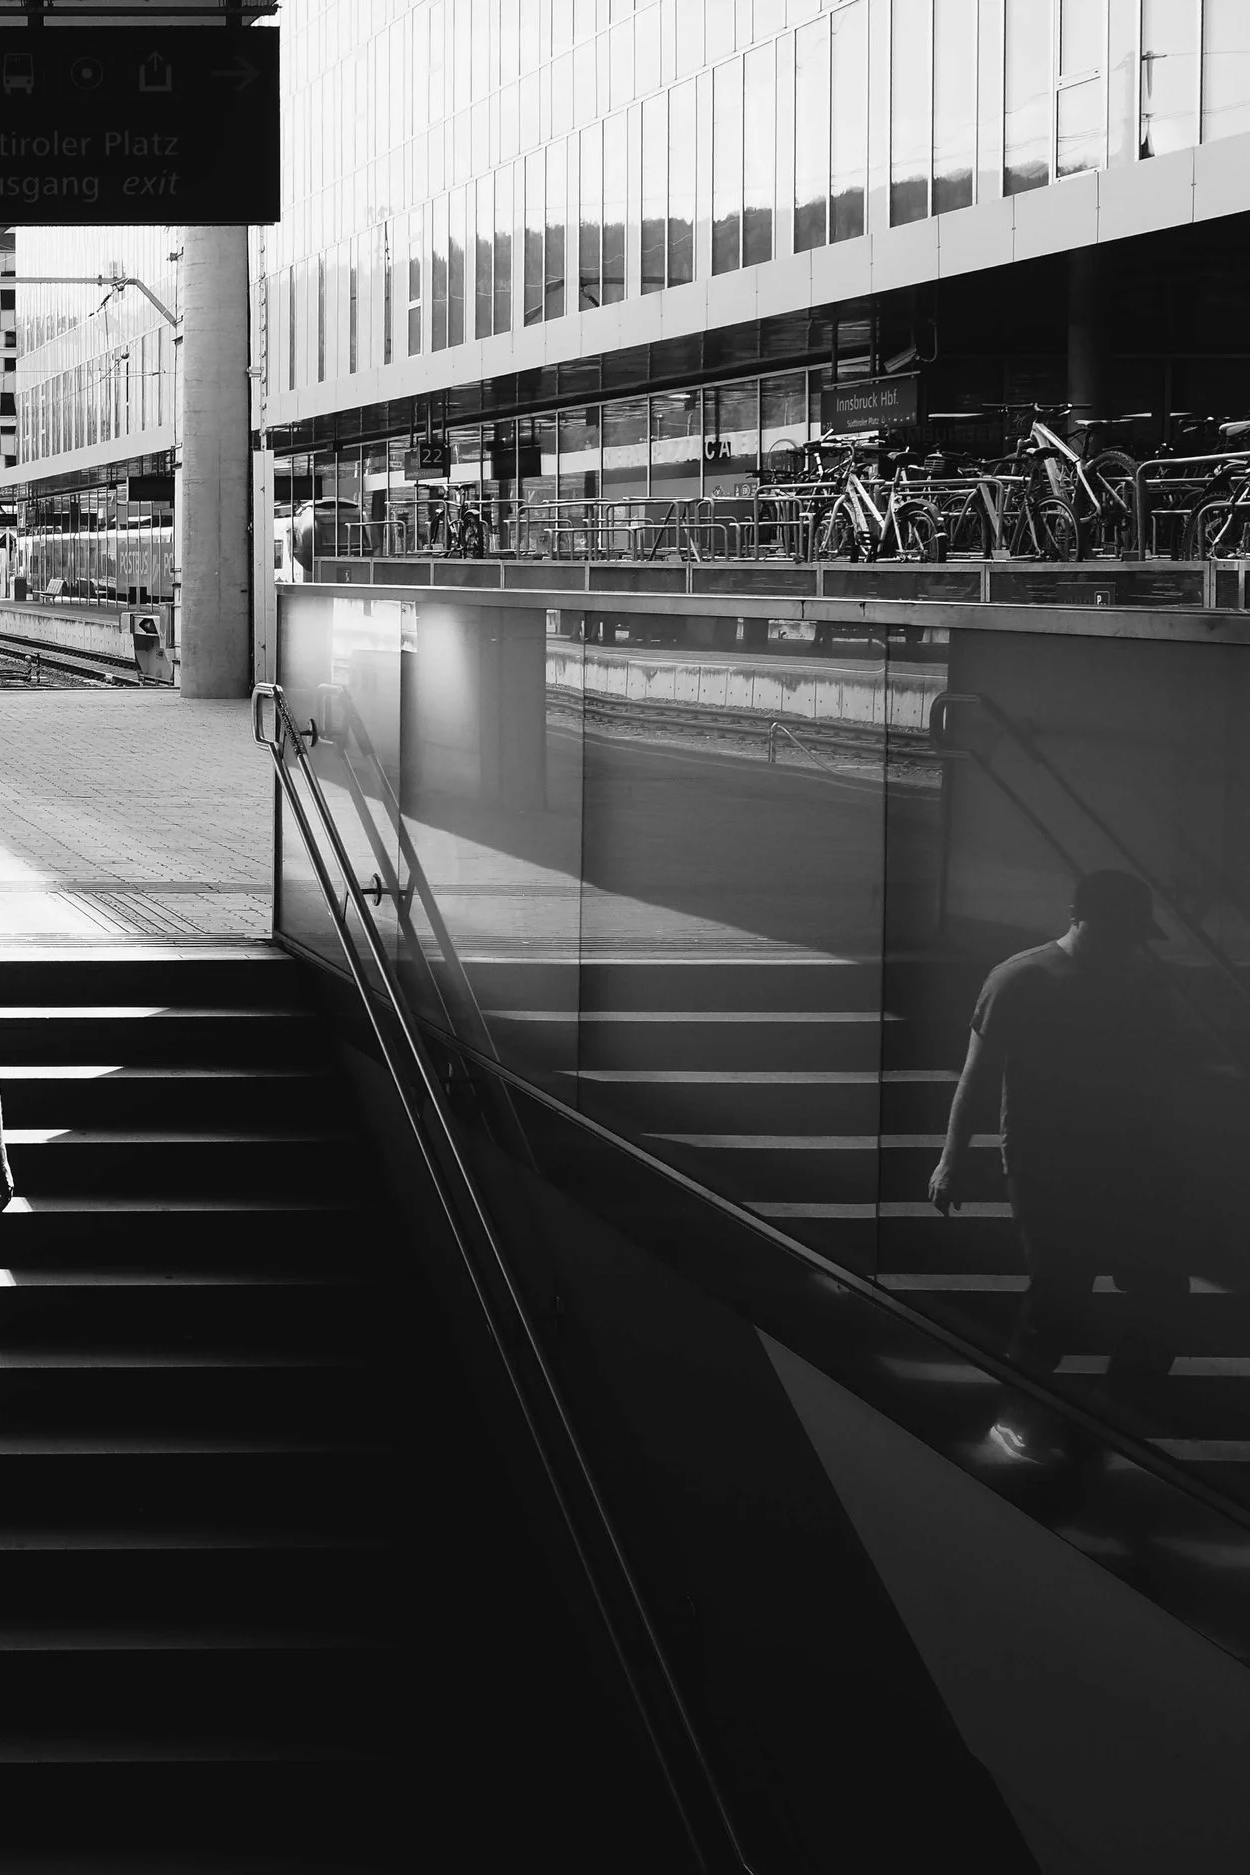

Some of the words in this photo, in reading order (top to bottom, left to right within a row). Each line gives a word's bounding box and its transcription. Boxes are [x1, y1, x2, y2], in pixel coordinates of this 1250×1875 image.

[105, 129, 180, 156] Platz
[122, 169, 181, 196] exit
[836, 392, 878, 412] Innsbruck
[880, 388, 900, 407] Hbf.
[422, 448, 443, 463] 22
